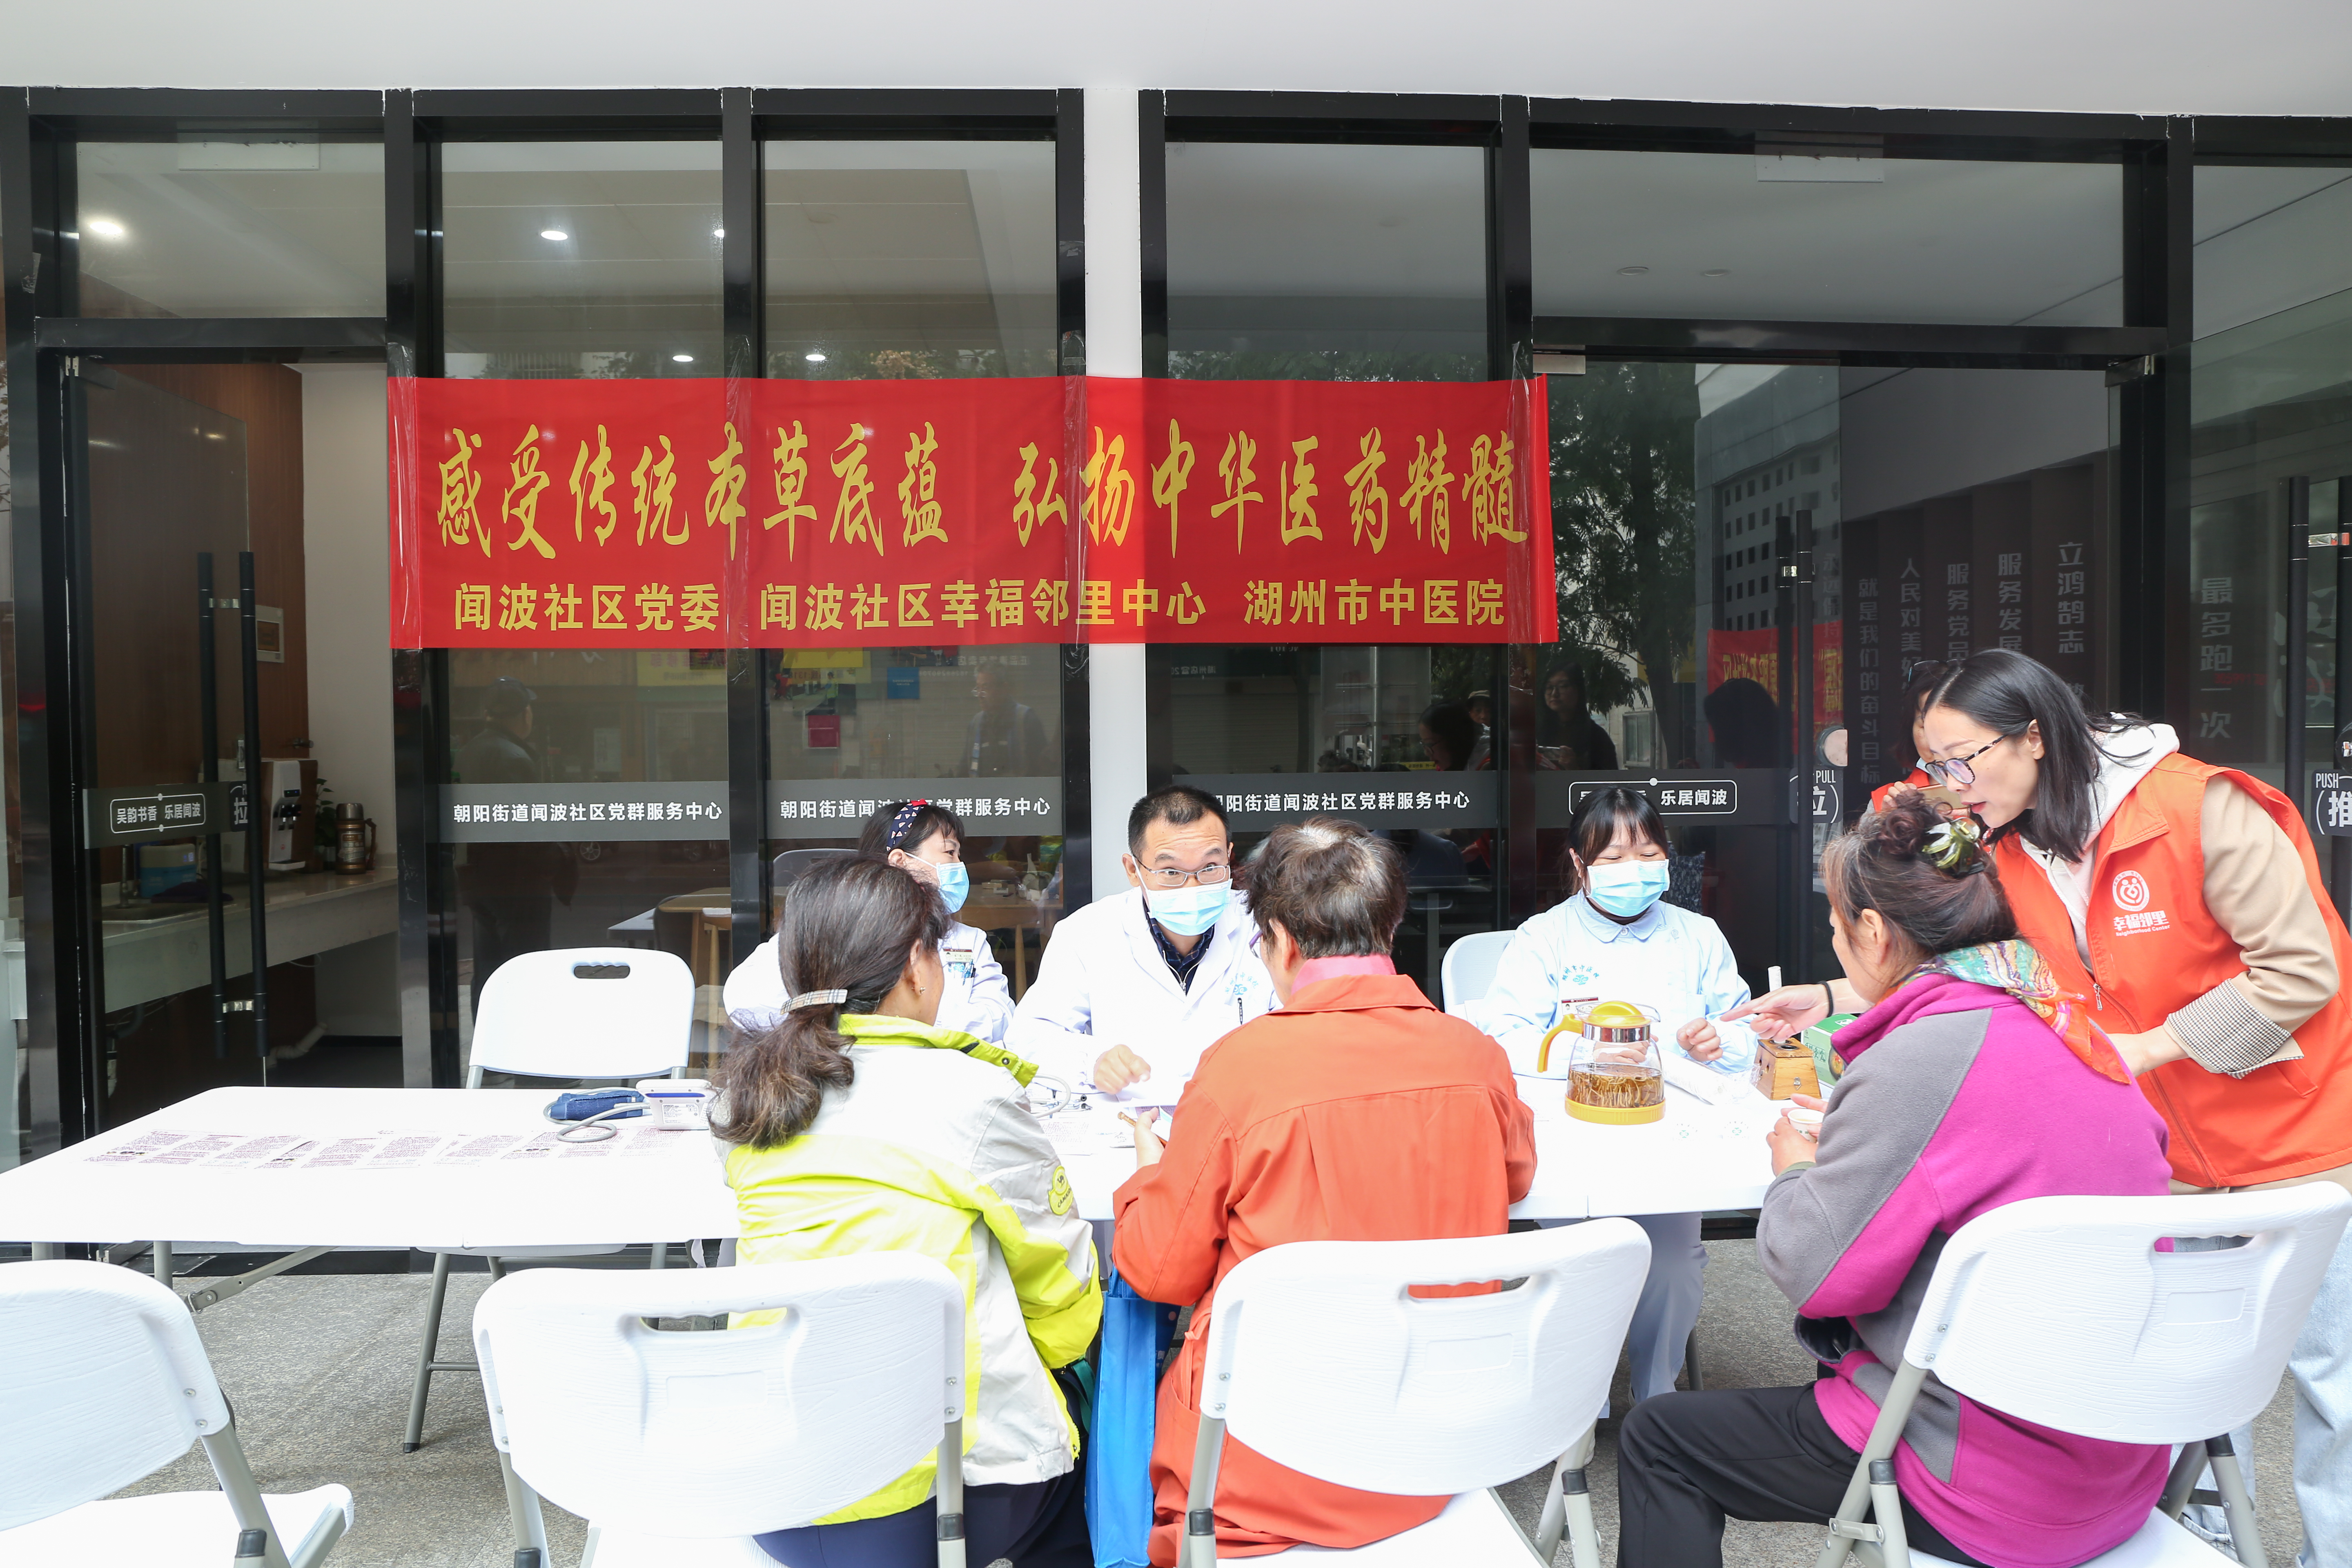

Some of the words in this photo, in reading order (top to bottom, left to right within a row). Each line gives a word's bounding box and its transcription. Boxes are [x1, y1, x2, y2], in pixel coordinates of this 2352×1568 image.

[438, 420, 948, 561] 感受传统本草底蕴
[1013, 419, 1528, 558] 弘扬中华医药精髓
[455, 583, 719, 632] 闻波社区党委
[761, 579, 1206, 631] 闻波社区幸福邻里中心
[1244, 579, 1504, 626] 湖州市中医院
[2058, 542, 2085, 653] 立鸿鹄志
[2200, 577, 2233, 738] 最多跑一次
[1859, 578, 1880, 784] 就是我们的奋斗目标
[1816, 770, 1836, 784] PULL
[2316, 773, 2339, 788] PUSH
[1660, 789, 1728, 806] 乐居闻波
[117, 805, 157, 824] 吴韵书香
[164, 802, 201, 820] 乐居闻波
[454, 802, 722, 822] 朝阳街道闻波社区党群服务中心
[2113, 910, 2169, 931] 幸福邻里
[2116, 927, 2151, 937] Neighborhood
